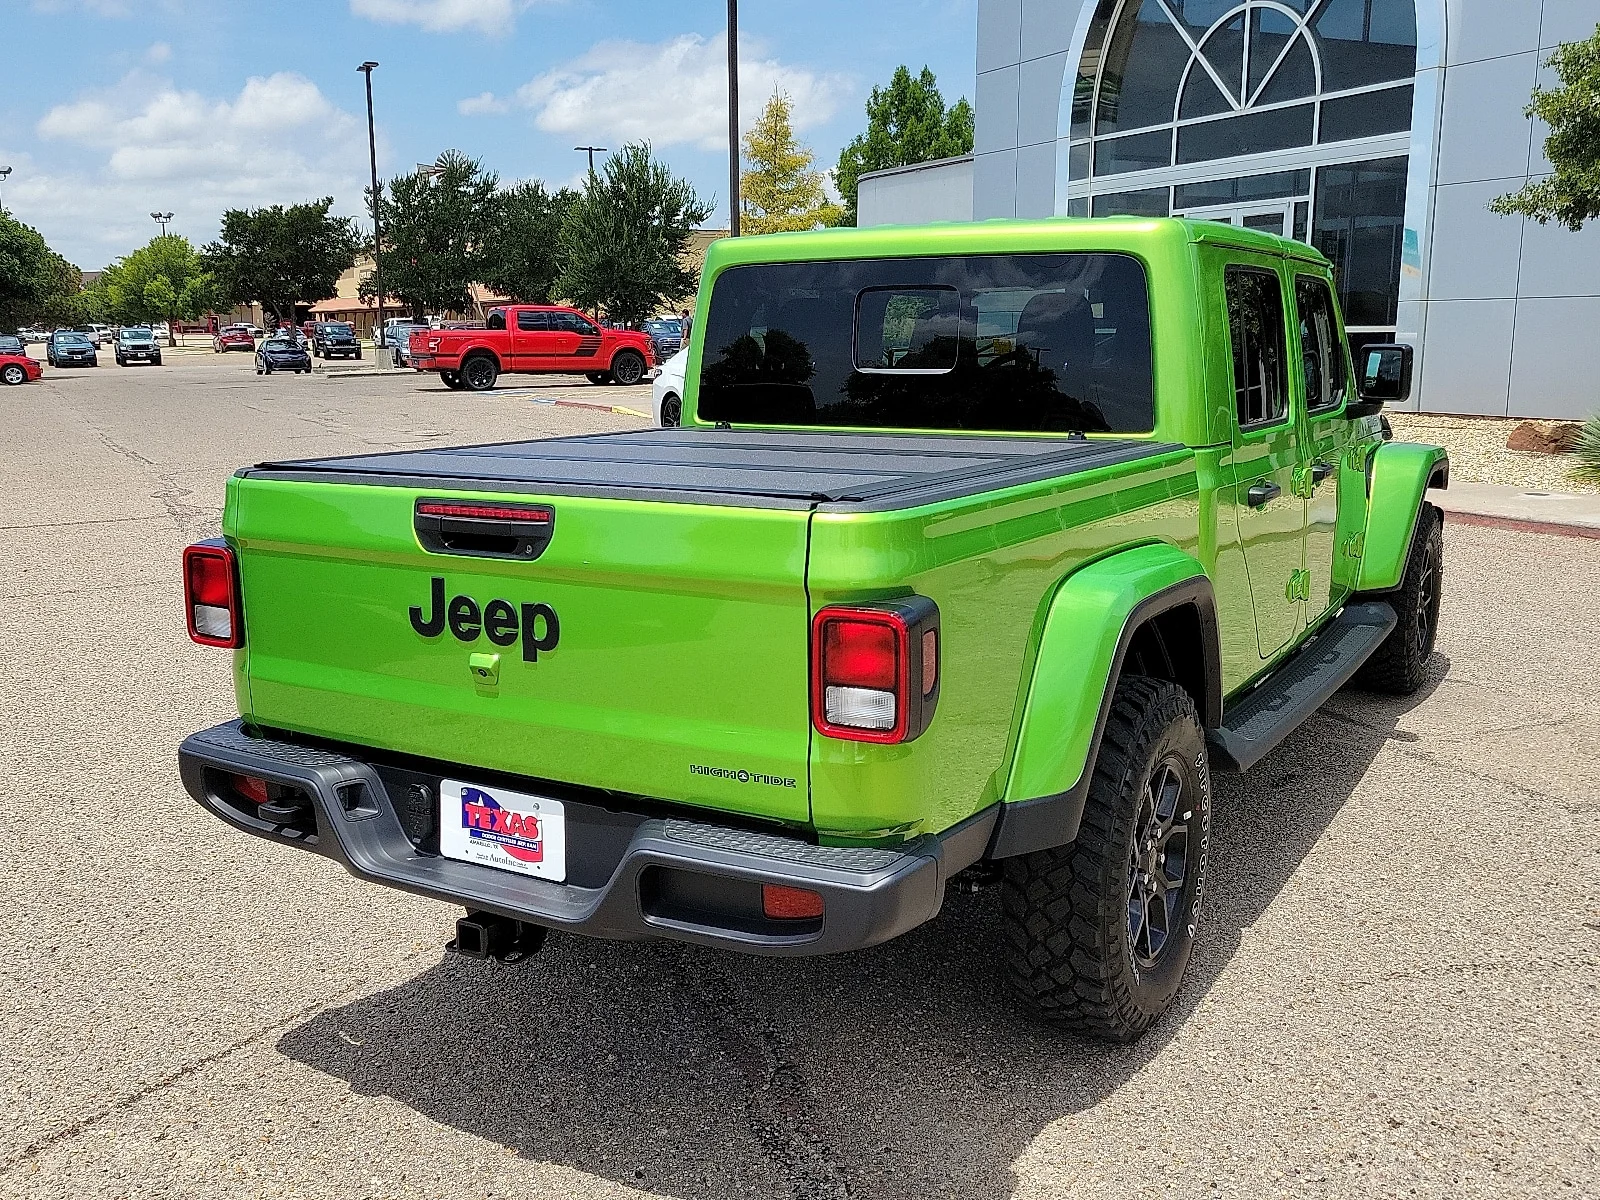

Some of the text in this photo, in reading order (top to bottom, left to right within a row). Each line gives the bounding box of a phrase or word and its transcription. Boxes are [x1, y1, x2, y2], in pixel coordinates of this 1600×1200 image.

[408, 576, 561, 663] Jeep
[689, 764, 797, 789] HIGH TIDE
[465, 803, 539, 840] TEXAS
